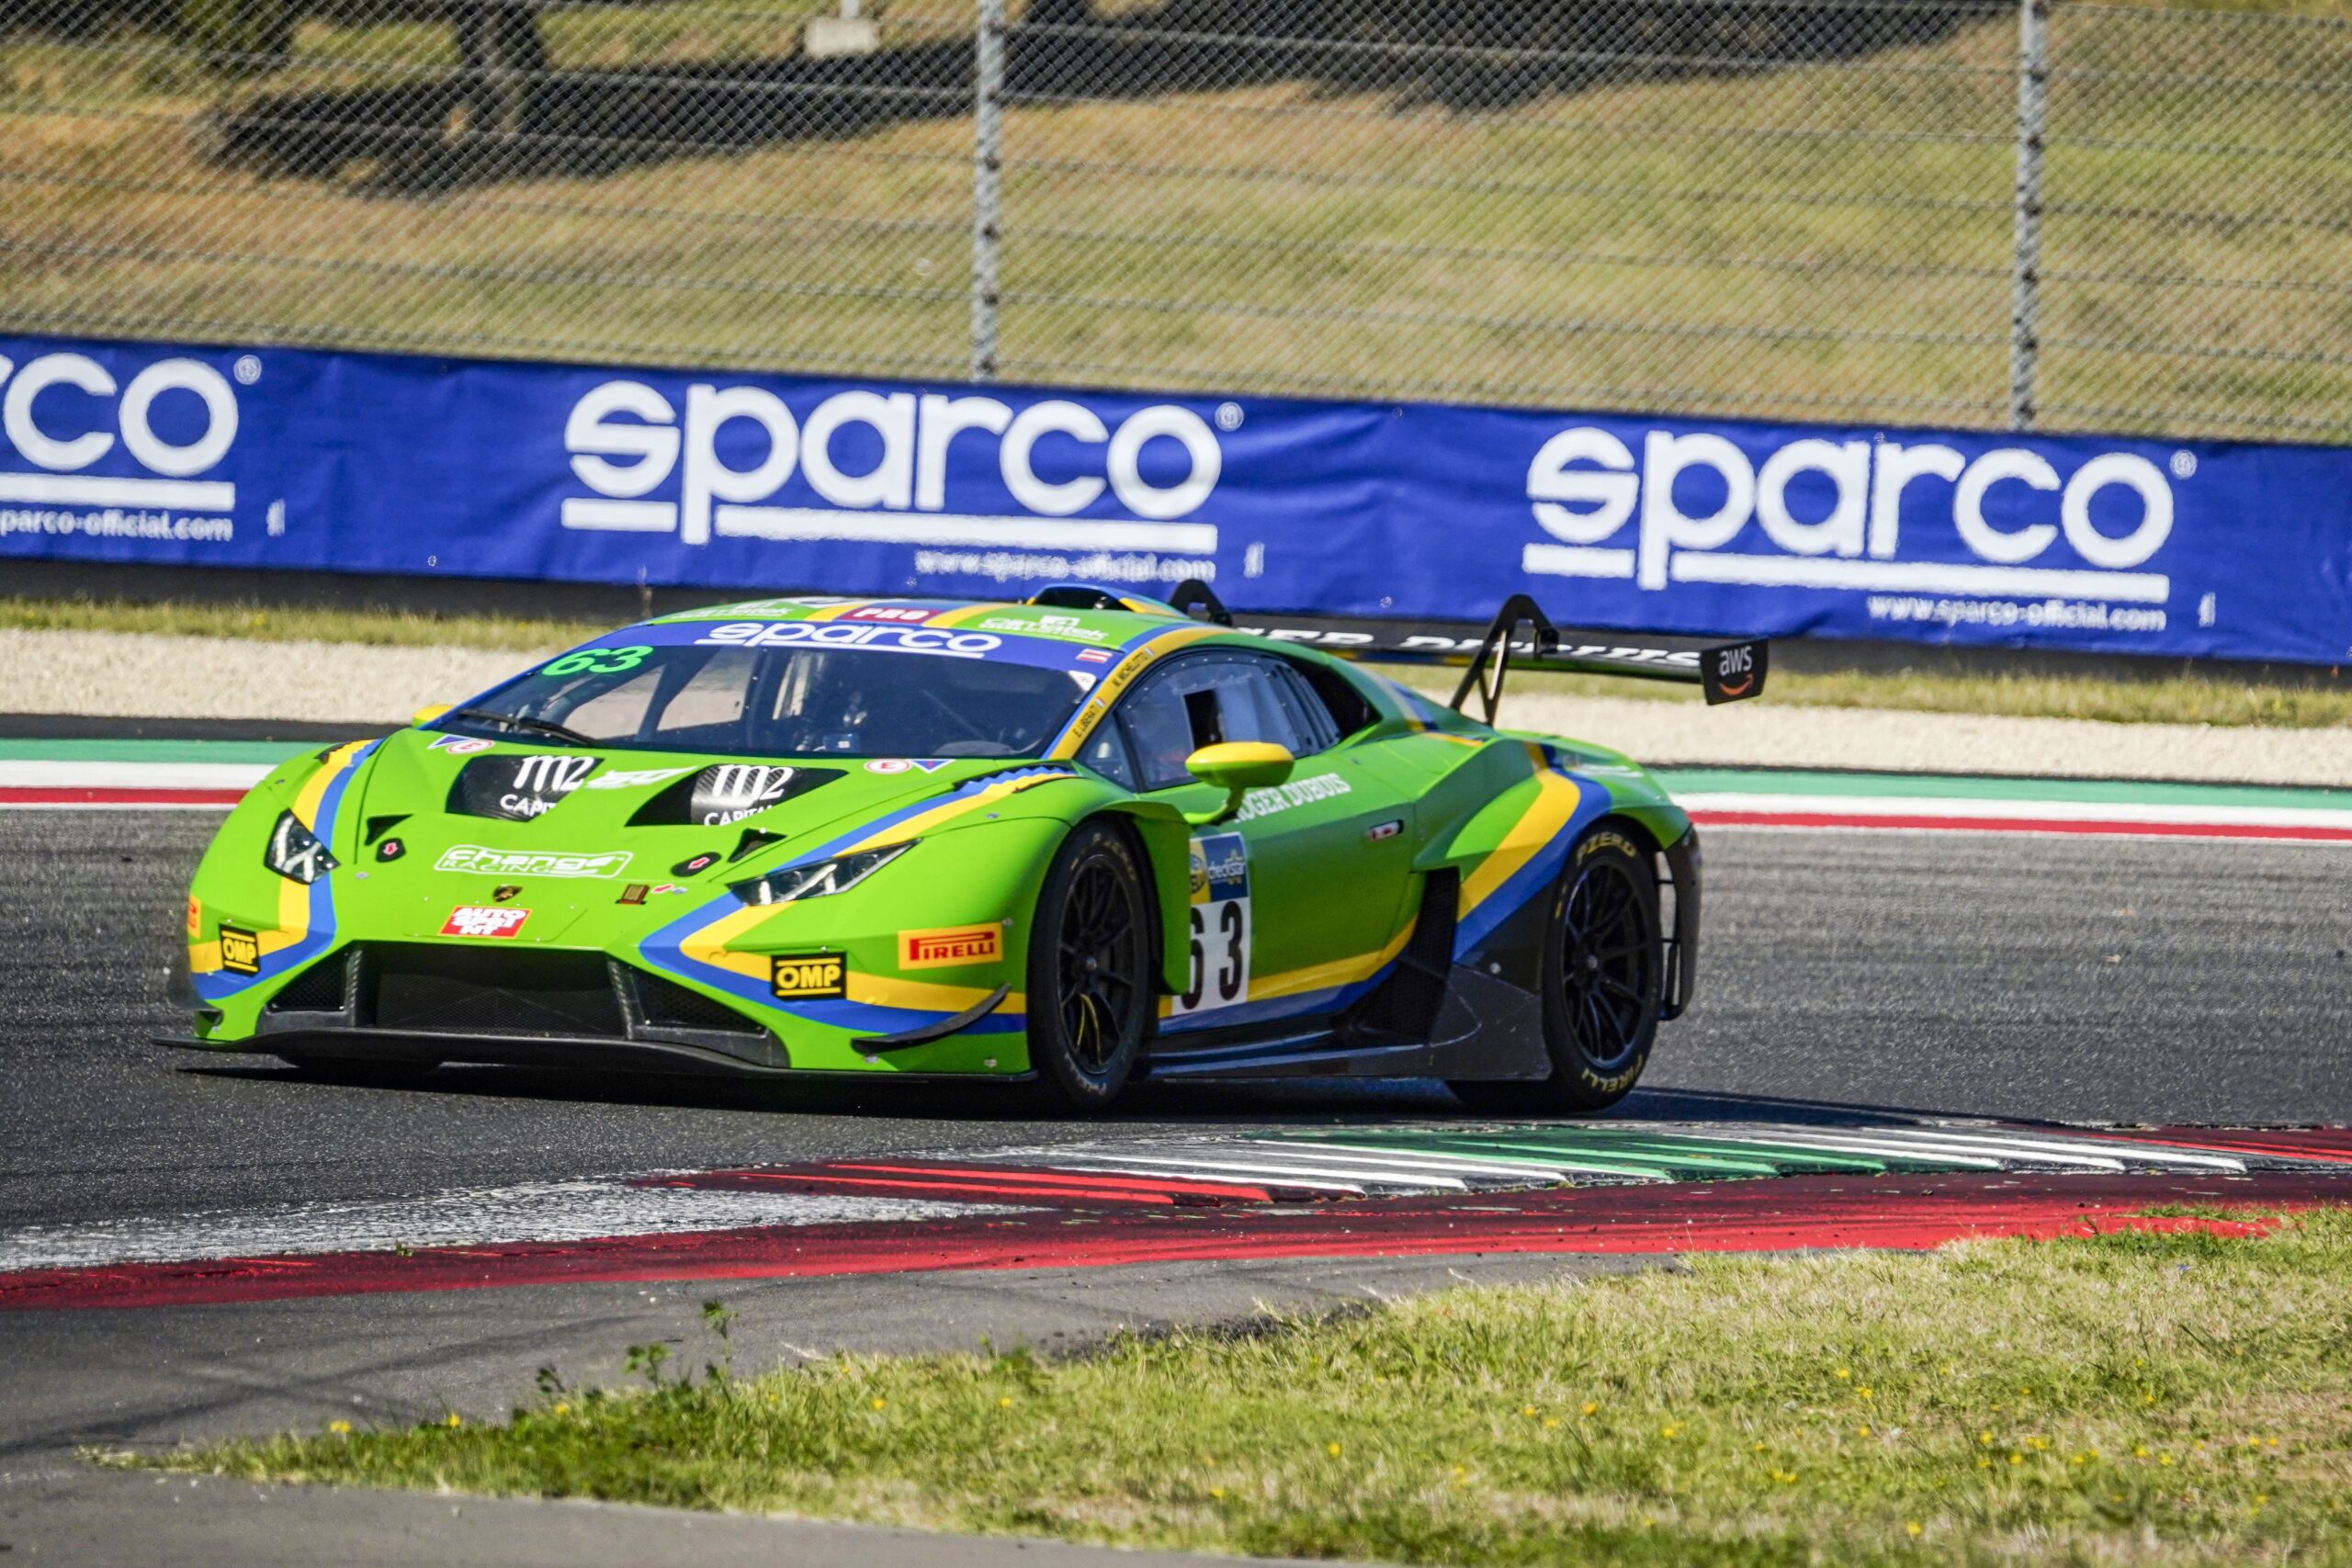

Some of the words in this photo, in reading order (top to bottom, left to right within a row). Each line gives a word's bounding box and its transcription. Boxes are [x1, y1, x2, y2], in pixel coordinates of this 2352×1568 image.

[564, 380, 1222, 545] sparco
[1526, 427, 2174, 590] sparco
[1867, 596, 2167, 632] www.sparco-official.com
[708, 622, 1002, 653] sparco
[542, 645, 653, 676] 63
[1719, 645, 1752, 677] aws
[1235, 787, 1291, 823] OGER
[1280, 773, 1352, 807] DUBUIS
[442, 860, 551, 874] RACING
[452, 908, 526, 920] AUTO
[223, 937, 256, 964] OMP
[909, 931, 994, 961] PIRELLI
[1182, 901, 1243, 1010] 63
[776, 964, 841, 989] OMP
